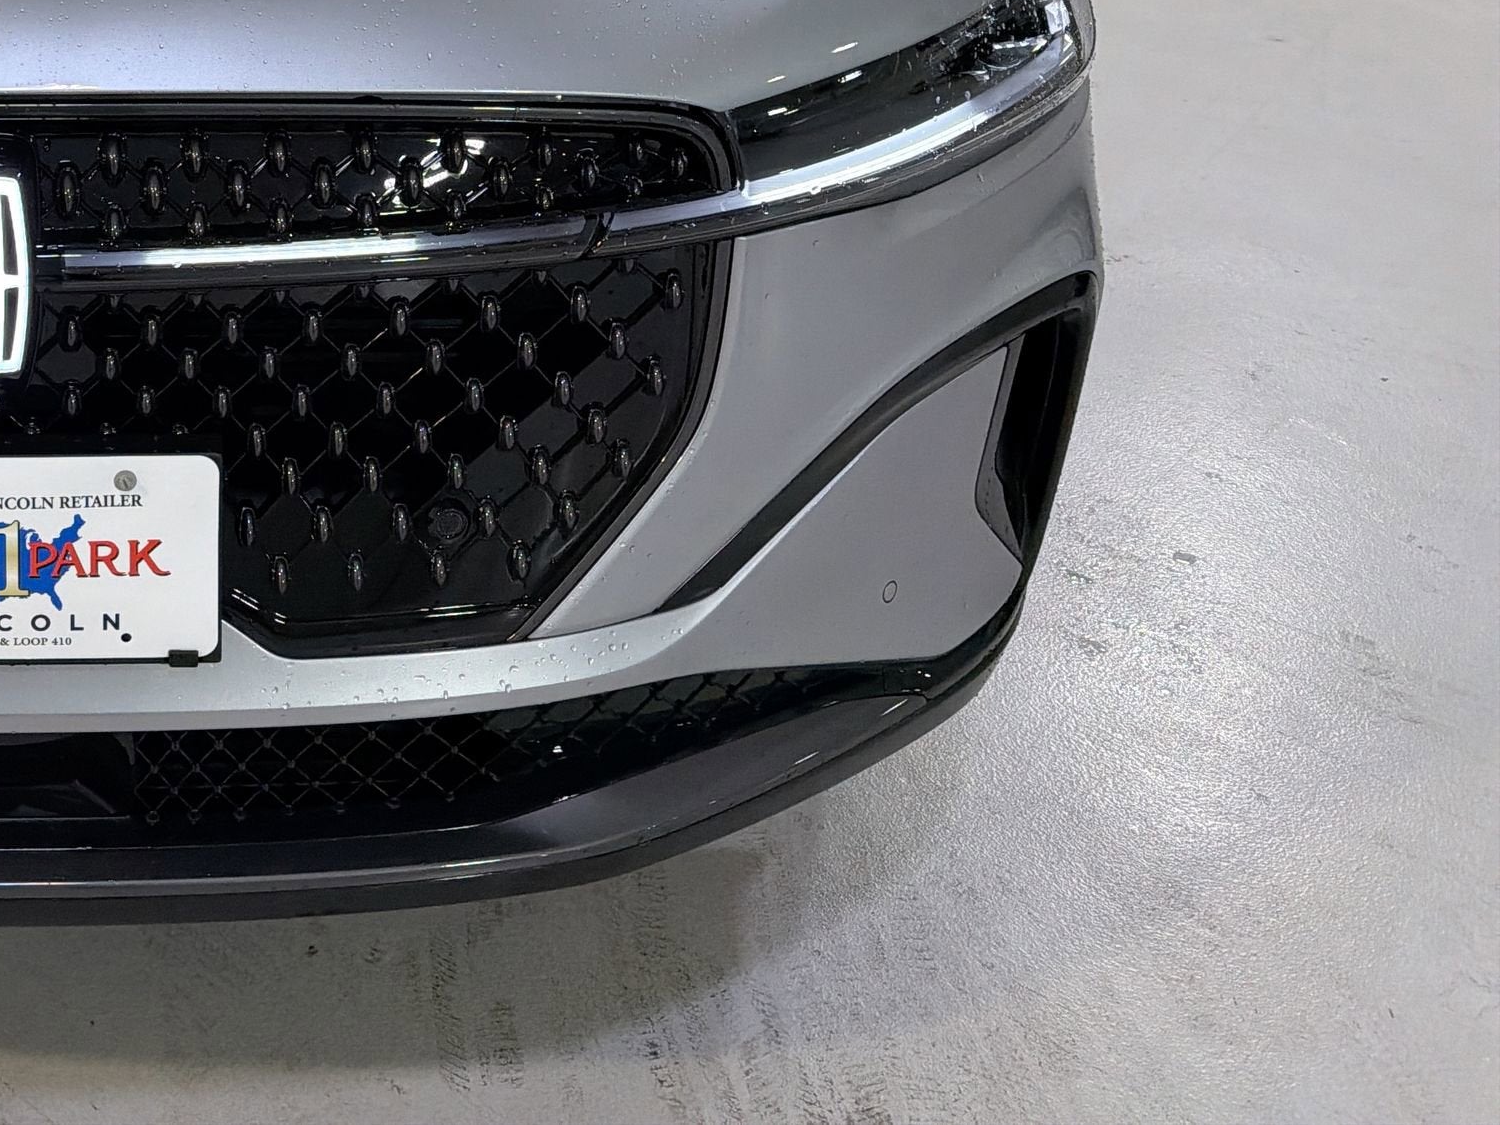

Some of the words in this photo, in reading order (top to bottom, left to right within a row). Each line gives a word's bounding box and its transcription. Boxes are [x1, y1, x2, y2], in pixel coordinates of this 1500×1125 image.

[59, 494, 143, 509] RETAILER
[28, 538, 172, 579] PARK
[0, 636, 10, 647] &
[13, 637, 48, 647] LOOP
[51, 636, 72, 647] 410
